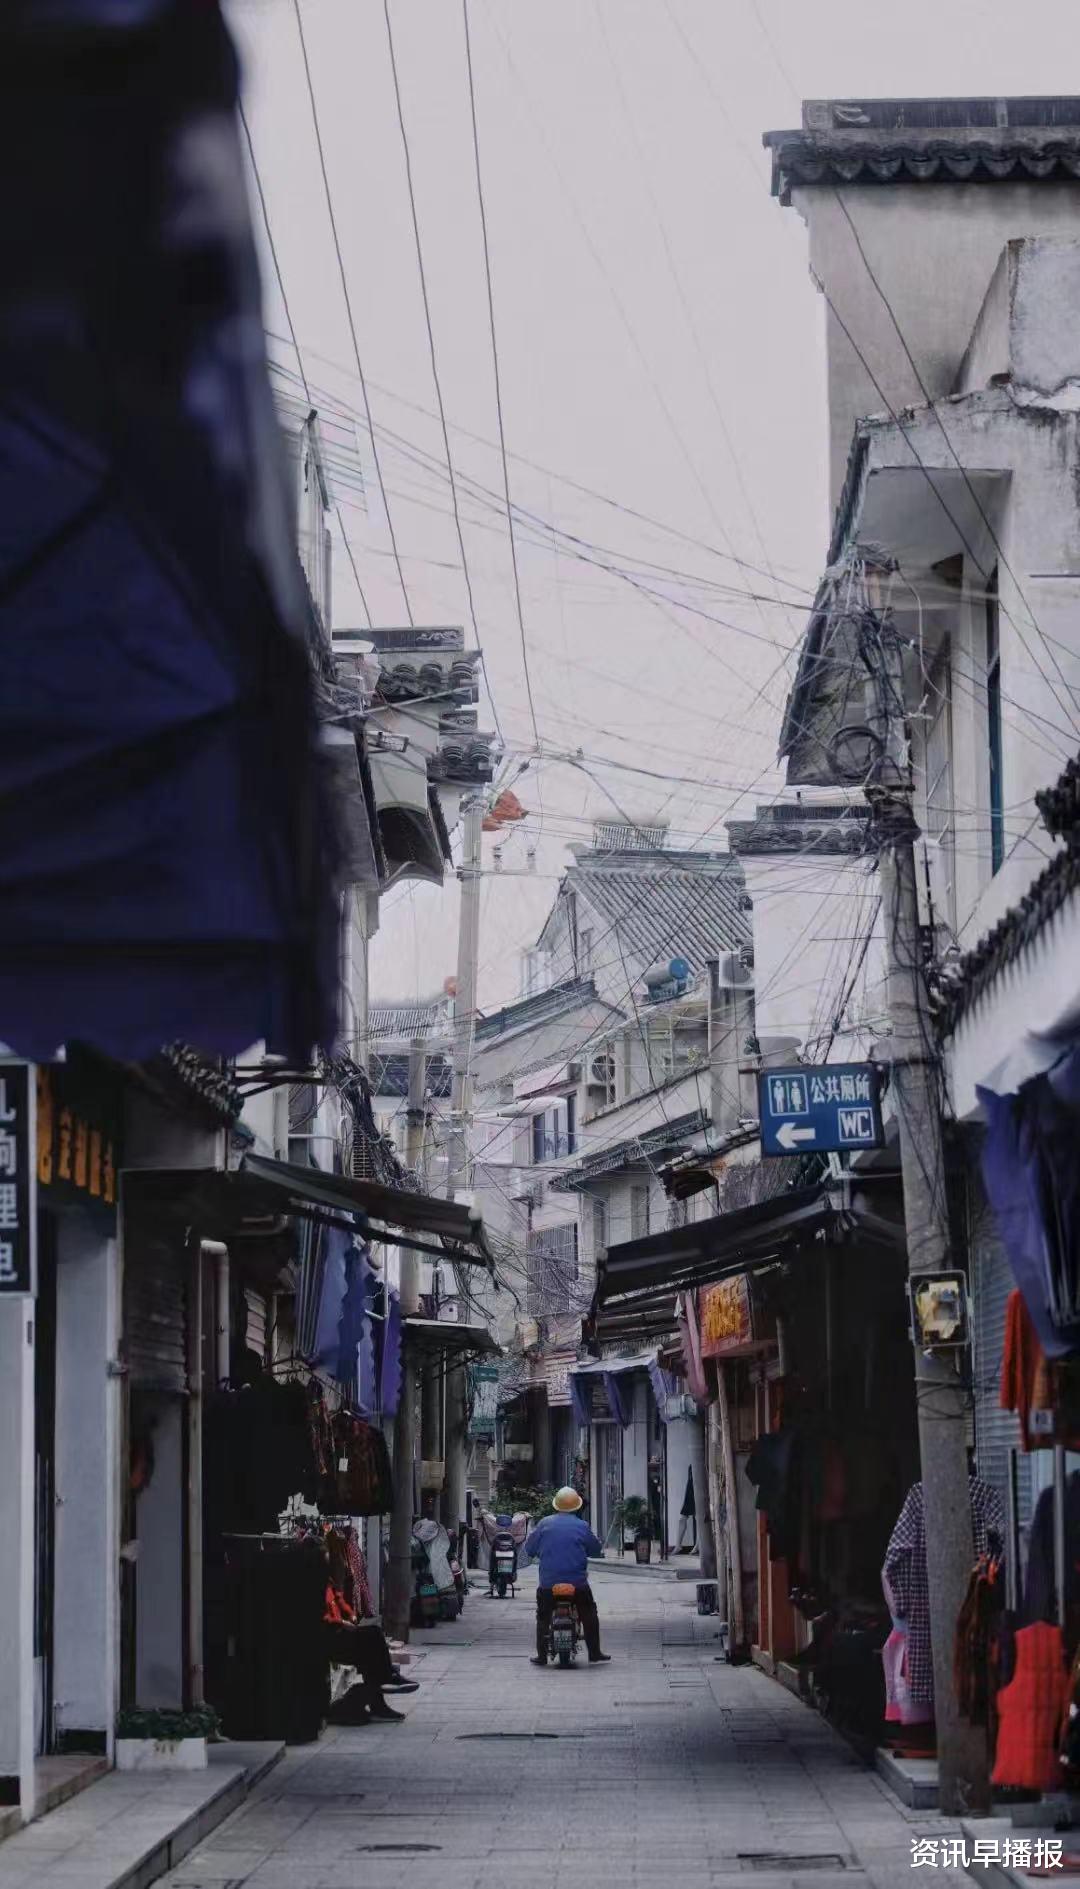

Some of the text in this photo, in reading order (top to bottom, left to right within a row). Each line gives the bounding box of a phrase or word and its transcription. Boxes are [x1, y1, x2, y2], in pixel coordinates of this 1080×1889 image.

[811, 1074, 870, 1103] 公共厕所
[841, 1112, 870, 1137] WC
